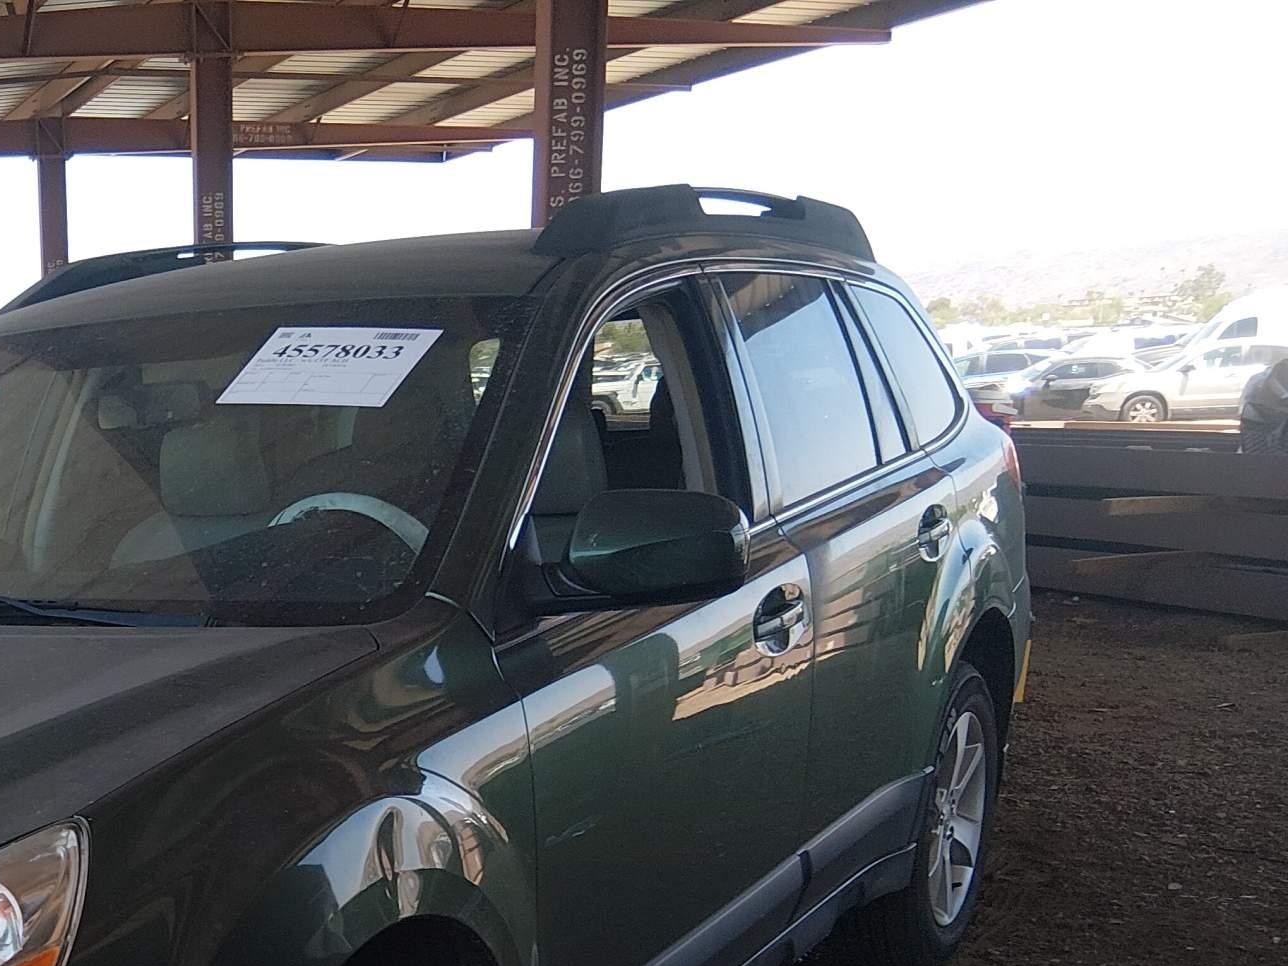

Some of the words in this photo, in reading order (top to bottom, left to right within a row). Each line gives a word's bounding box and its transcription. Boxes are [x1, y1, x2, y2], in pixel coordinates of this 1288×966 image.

[553, 46, 571, 86] INC.
[551, 97, 569, 177] PREFAB
[567, 48, 588, 203] 66-799-0969
[272, 344, 405, 360] 45578033
